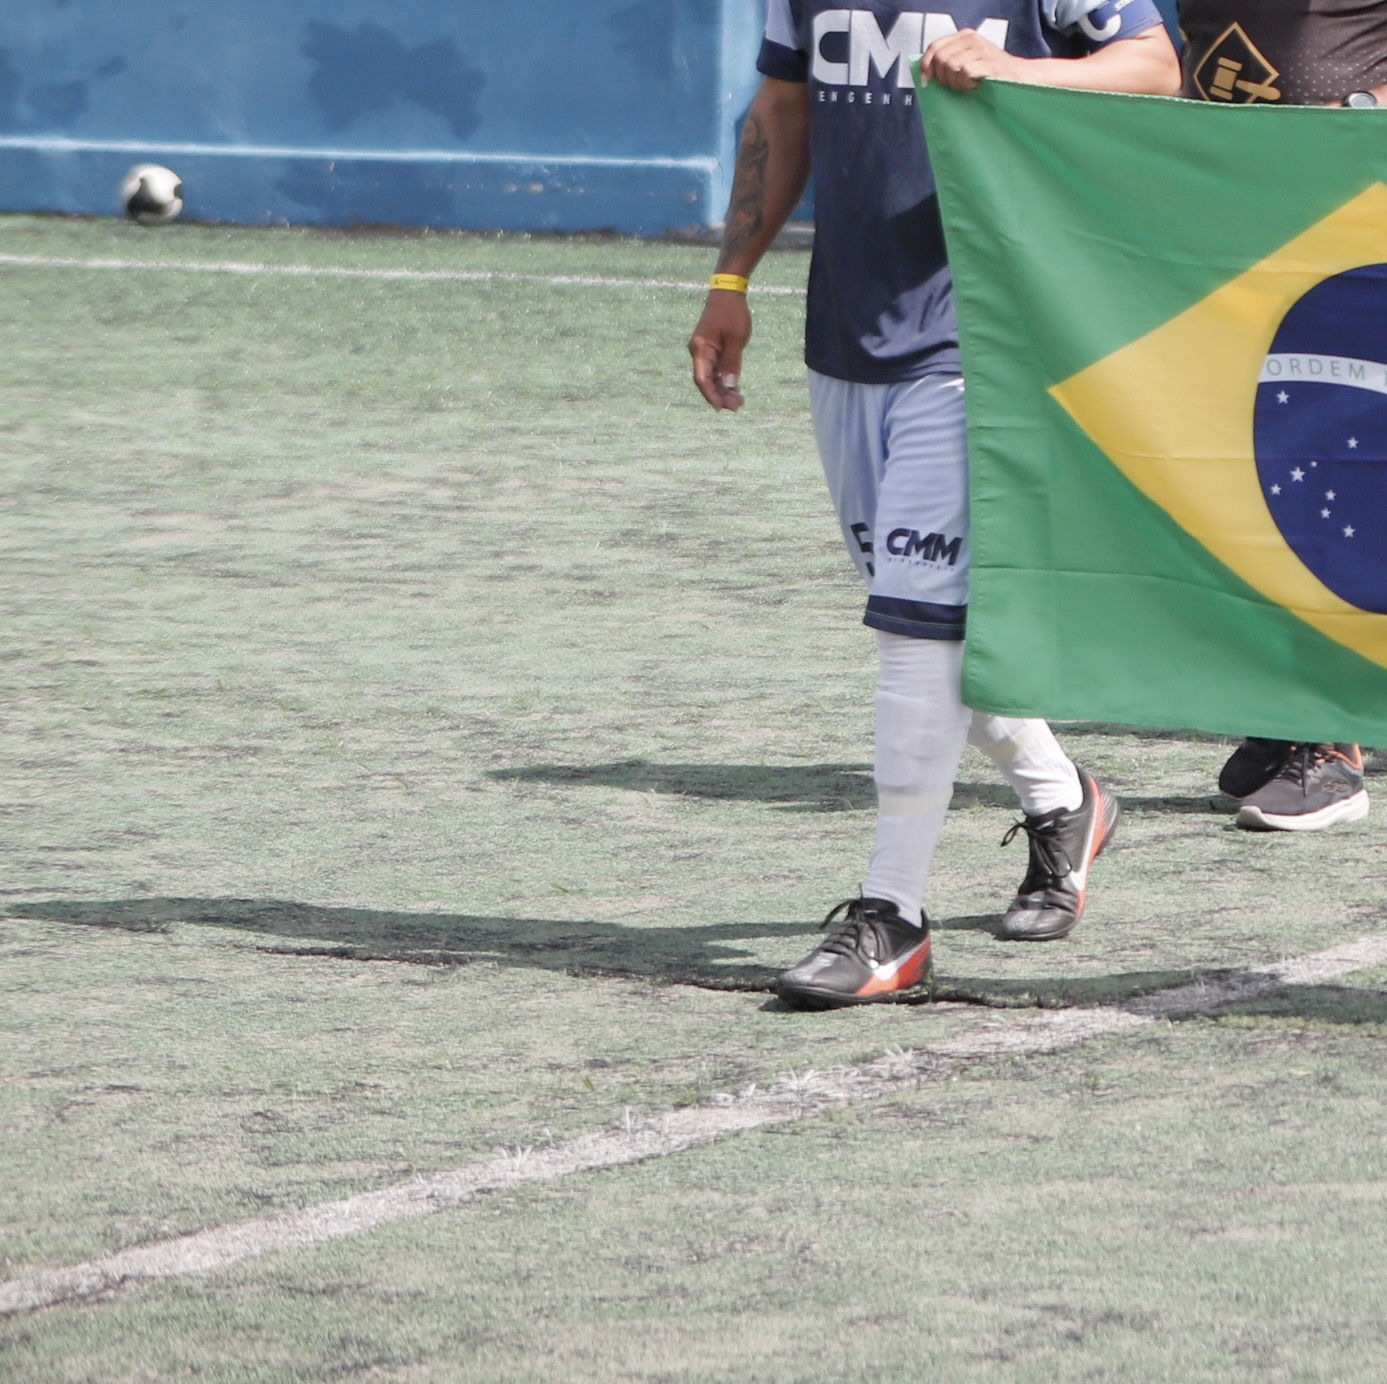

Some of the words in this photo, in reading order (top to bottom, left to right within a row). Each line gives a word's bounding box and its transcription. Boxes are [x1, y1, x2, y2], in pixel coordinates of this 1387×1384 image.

[818, 89, 914, 107] ENGENH
[1266, 358, 1366, 381] ORDEM
[886, 527, 963, 566] CMM
